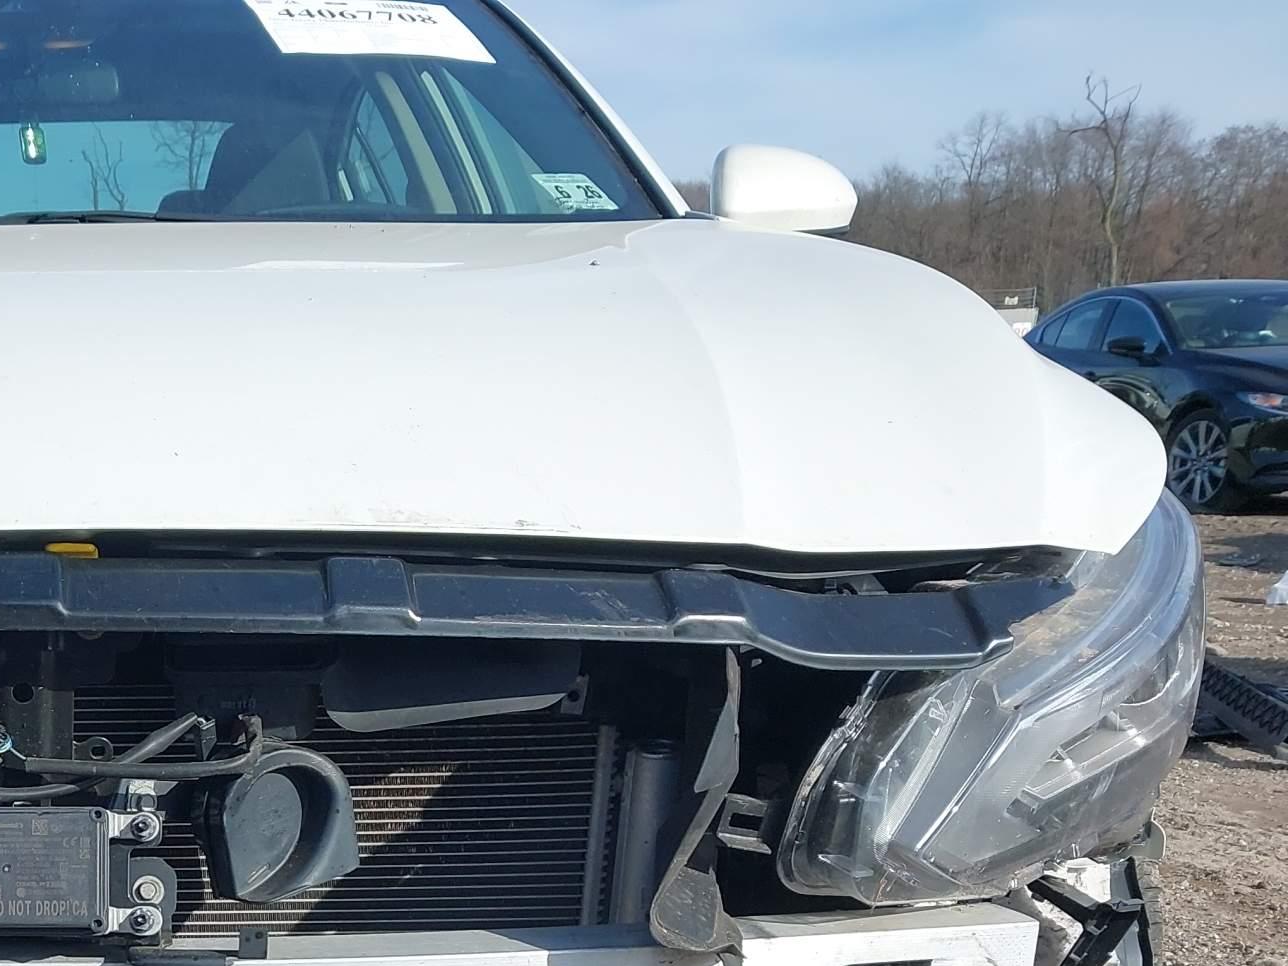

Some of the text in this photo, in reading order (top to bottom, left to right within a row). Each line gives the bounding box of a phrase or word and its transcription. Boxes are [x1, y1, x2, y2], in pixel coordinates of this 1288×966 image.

[277, 8, 439, 25] 44067708
[554, 184, 603, 199] 6 26
[8, 900, 32, 916] NOT
